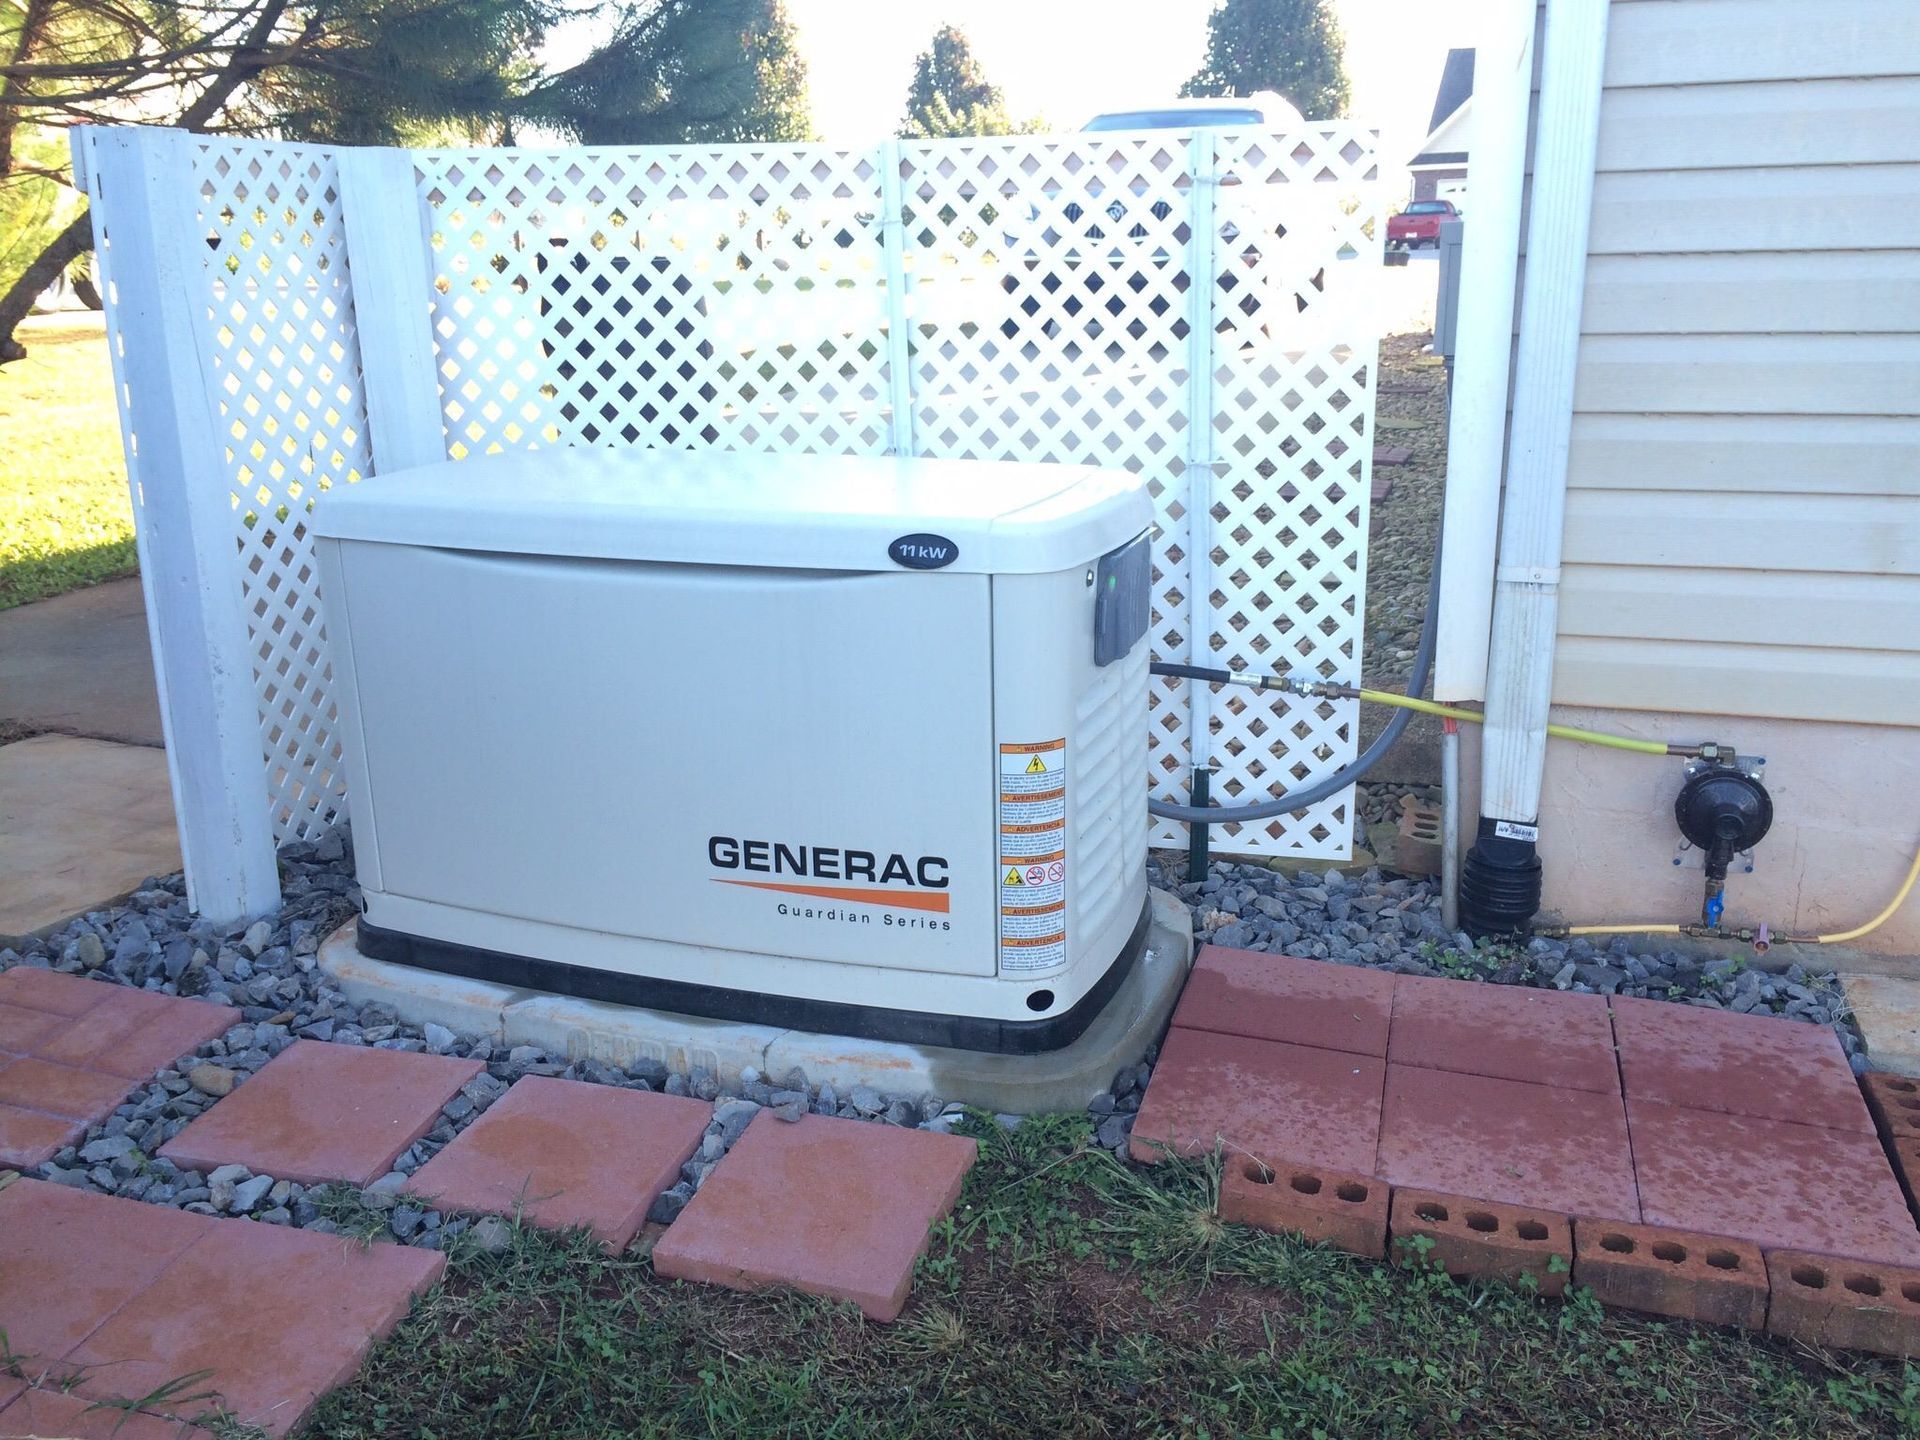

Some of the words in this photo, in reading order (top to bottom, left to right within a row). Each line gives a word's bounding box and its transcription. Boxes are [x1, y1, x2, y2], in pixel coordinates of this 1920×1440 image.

[1024, 743, 1055, 752] WARNING
[708, 836, 949, 888] GENERAC
[777, 903, 870, 924] Guardian
[883, 914, 951, 931] Series
